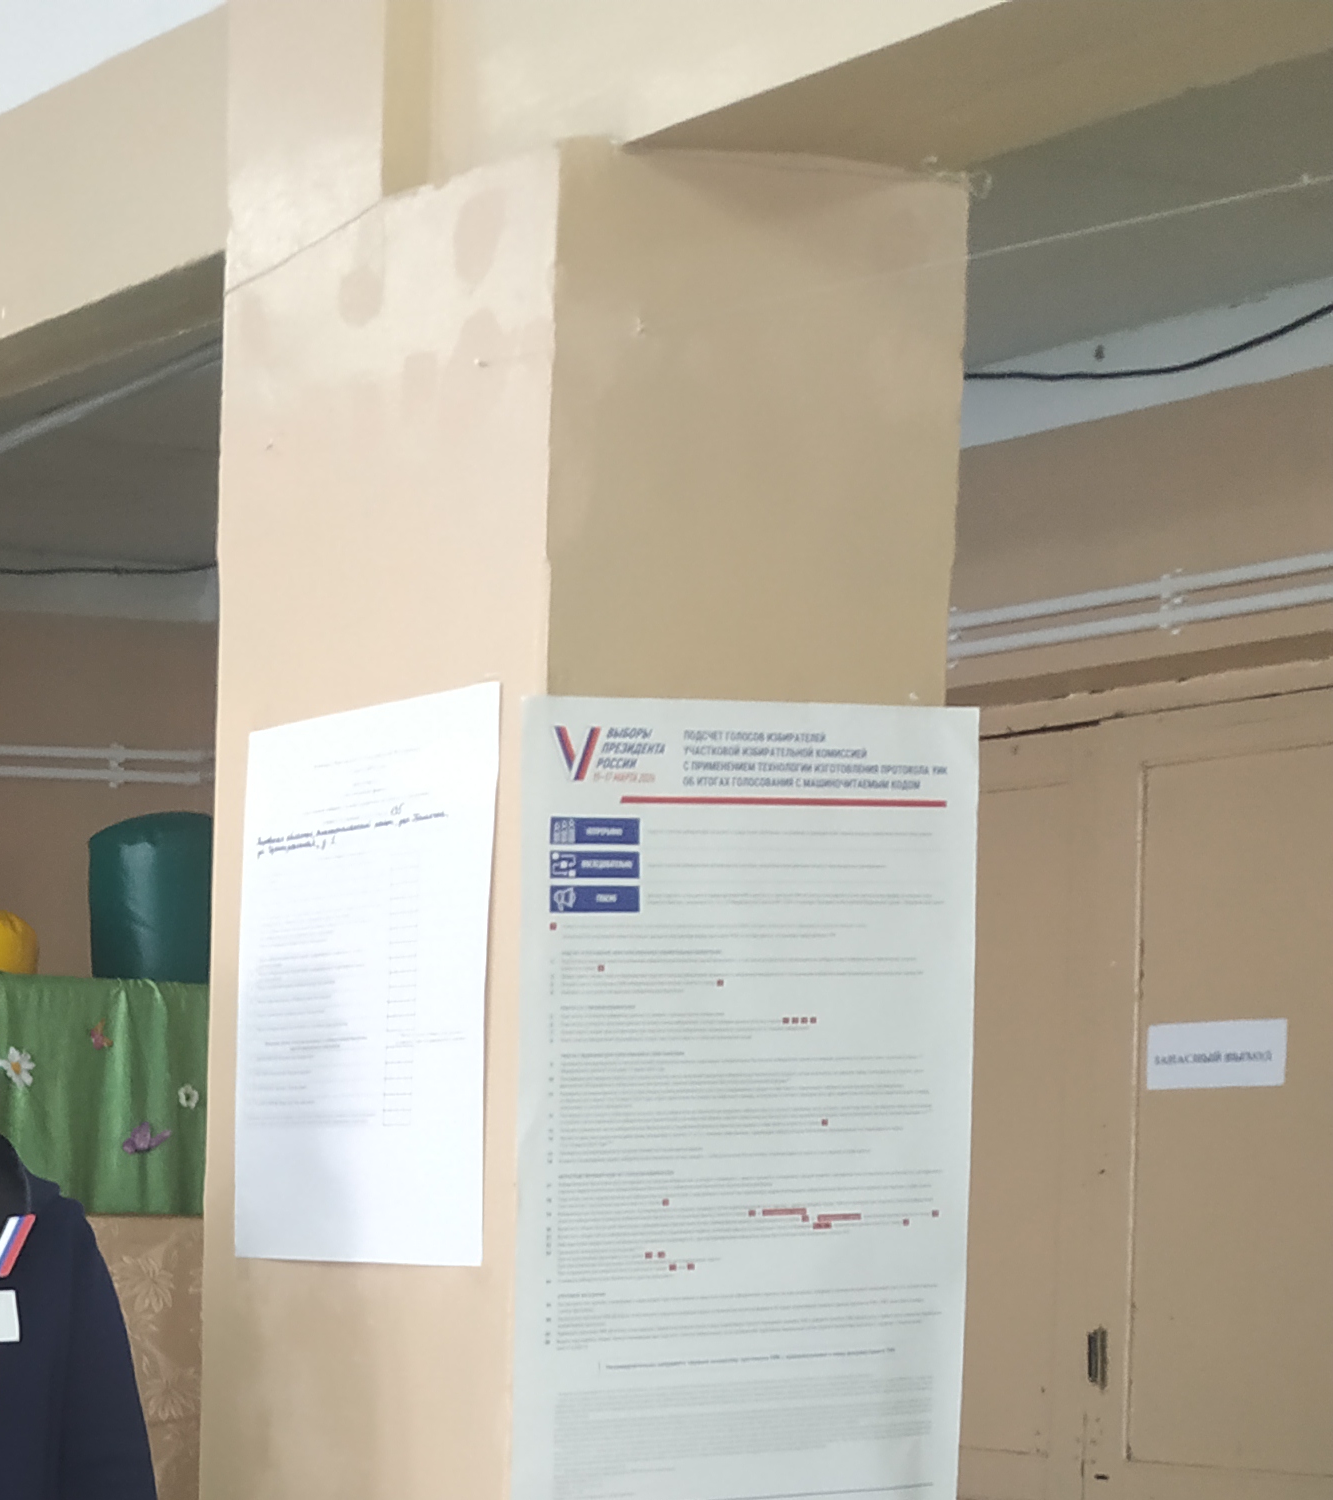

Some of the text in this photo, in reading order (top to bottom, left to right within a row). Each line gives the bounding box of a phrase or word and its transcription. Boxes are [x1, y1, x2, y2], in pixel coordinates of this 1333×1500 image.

[606, 727, 653, 739] ВЫБОРЫ
[725, 731, 764, 742] ГОЛОСОВ
[767, 731, 825, 743] ИЗБИРАТЕЛЕЙ
[600, 742, 666, 755] ПРЕЗИДЕНТА
[683, 745, 868, 759] УЧАСТКОВОЙ ИЗБИРАТЕЛЬНОЙ КОМИССИЕЙ
[596, 757, 638, 769] РОССИИ
[682, 761, 689, 772] С
[691, 761, 755, 772] ПРИМЕНЕНИЕМ
[757, 762, 812, 773] ТЕХНОЛОГИИ
[814, 763, 879, 774] ИЗГОТОВЛЕНИЯ
[880, 764, 929, 775] ПРОТОКОЛА
[682, 776, 921, 791] ОБ ИТОГАХ ГОЛОСОВАНИЯ С МАШИНОЧИТАЕМЫМ КОДОМ
